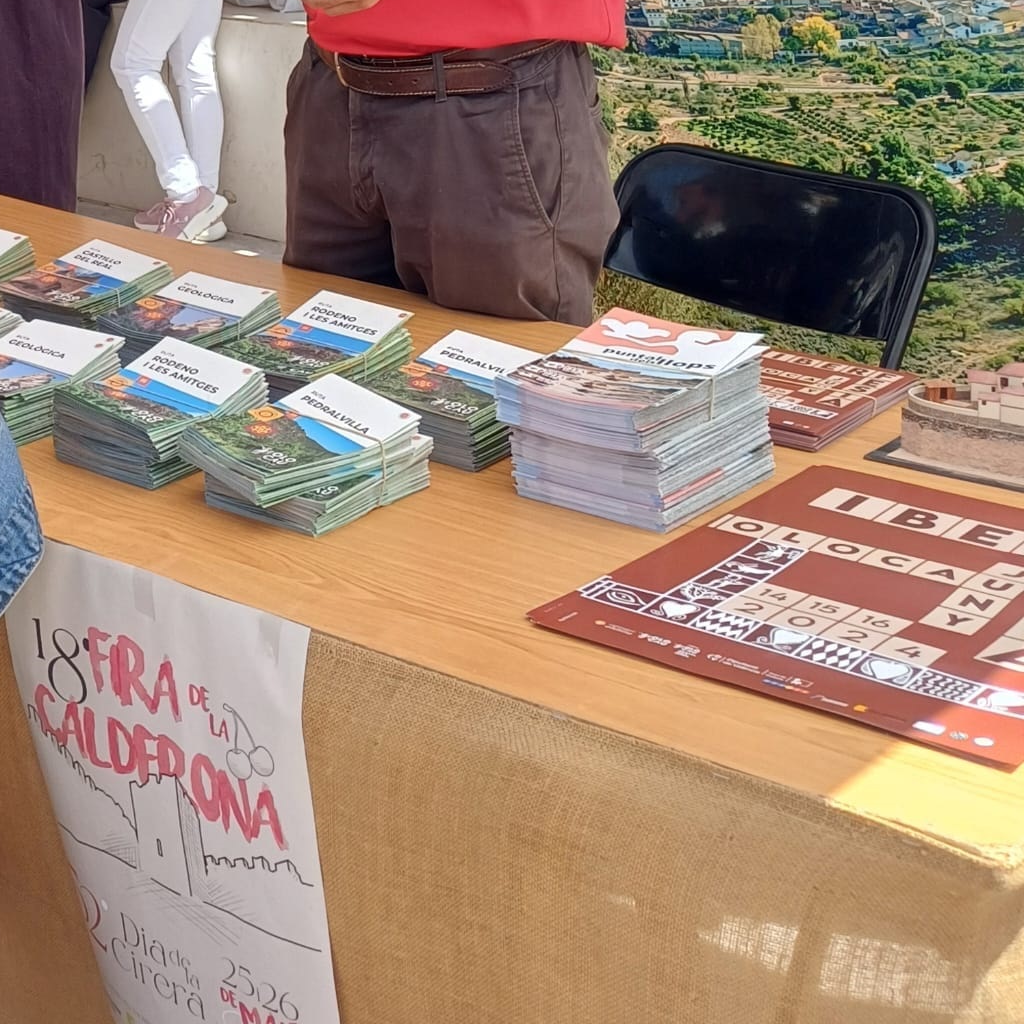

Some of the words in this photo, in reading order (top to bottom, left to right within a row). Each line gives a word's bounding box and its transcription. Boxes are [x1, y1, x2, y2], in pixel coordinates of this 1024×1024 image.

[74, 254, 89, 263] DEL
[90, 259, 113, 270] REAL
[82, 250, 122, 265] CASTILLO
[309, 314, 330, 323] LES
[329, 320, 378, 336] AMITGES
[311, 306, 357, 322] RODENO
[149, 363, 170, 375] LES
[169, 371, 220, 394] AMITGES
[152, 355, 200, 375] RODENO
[300, 394, 371, 435] PEDRALVILLA
[732, 521, 1015, 592] OLOCAU
[758, 587, 788, 602] 14
[809, 600, 841, 615] 15
[865, 615, 890, 629] 16
[86, 626, 183, 723] FIRA
[188, 683, 211, 713] DE
[208, 712, 230, 744] LA
[119, 911, 167, 968] Dia
[111, 937, 206, 1021] Cirera
[219, 986, 238, 1009] DE
